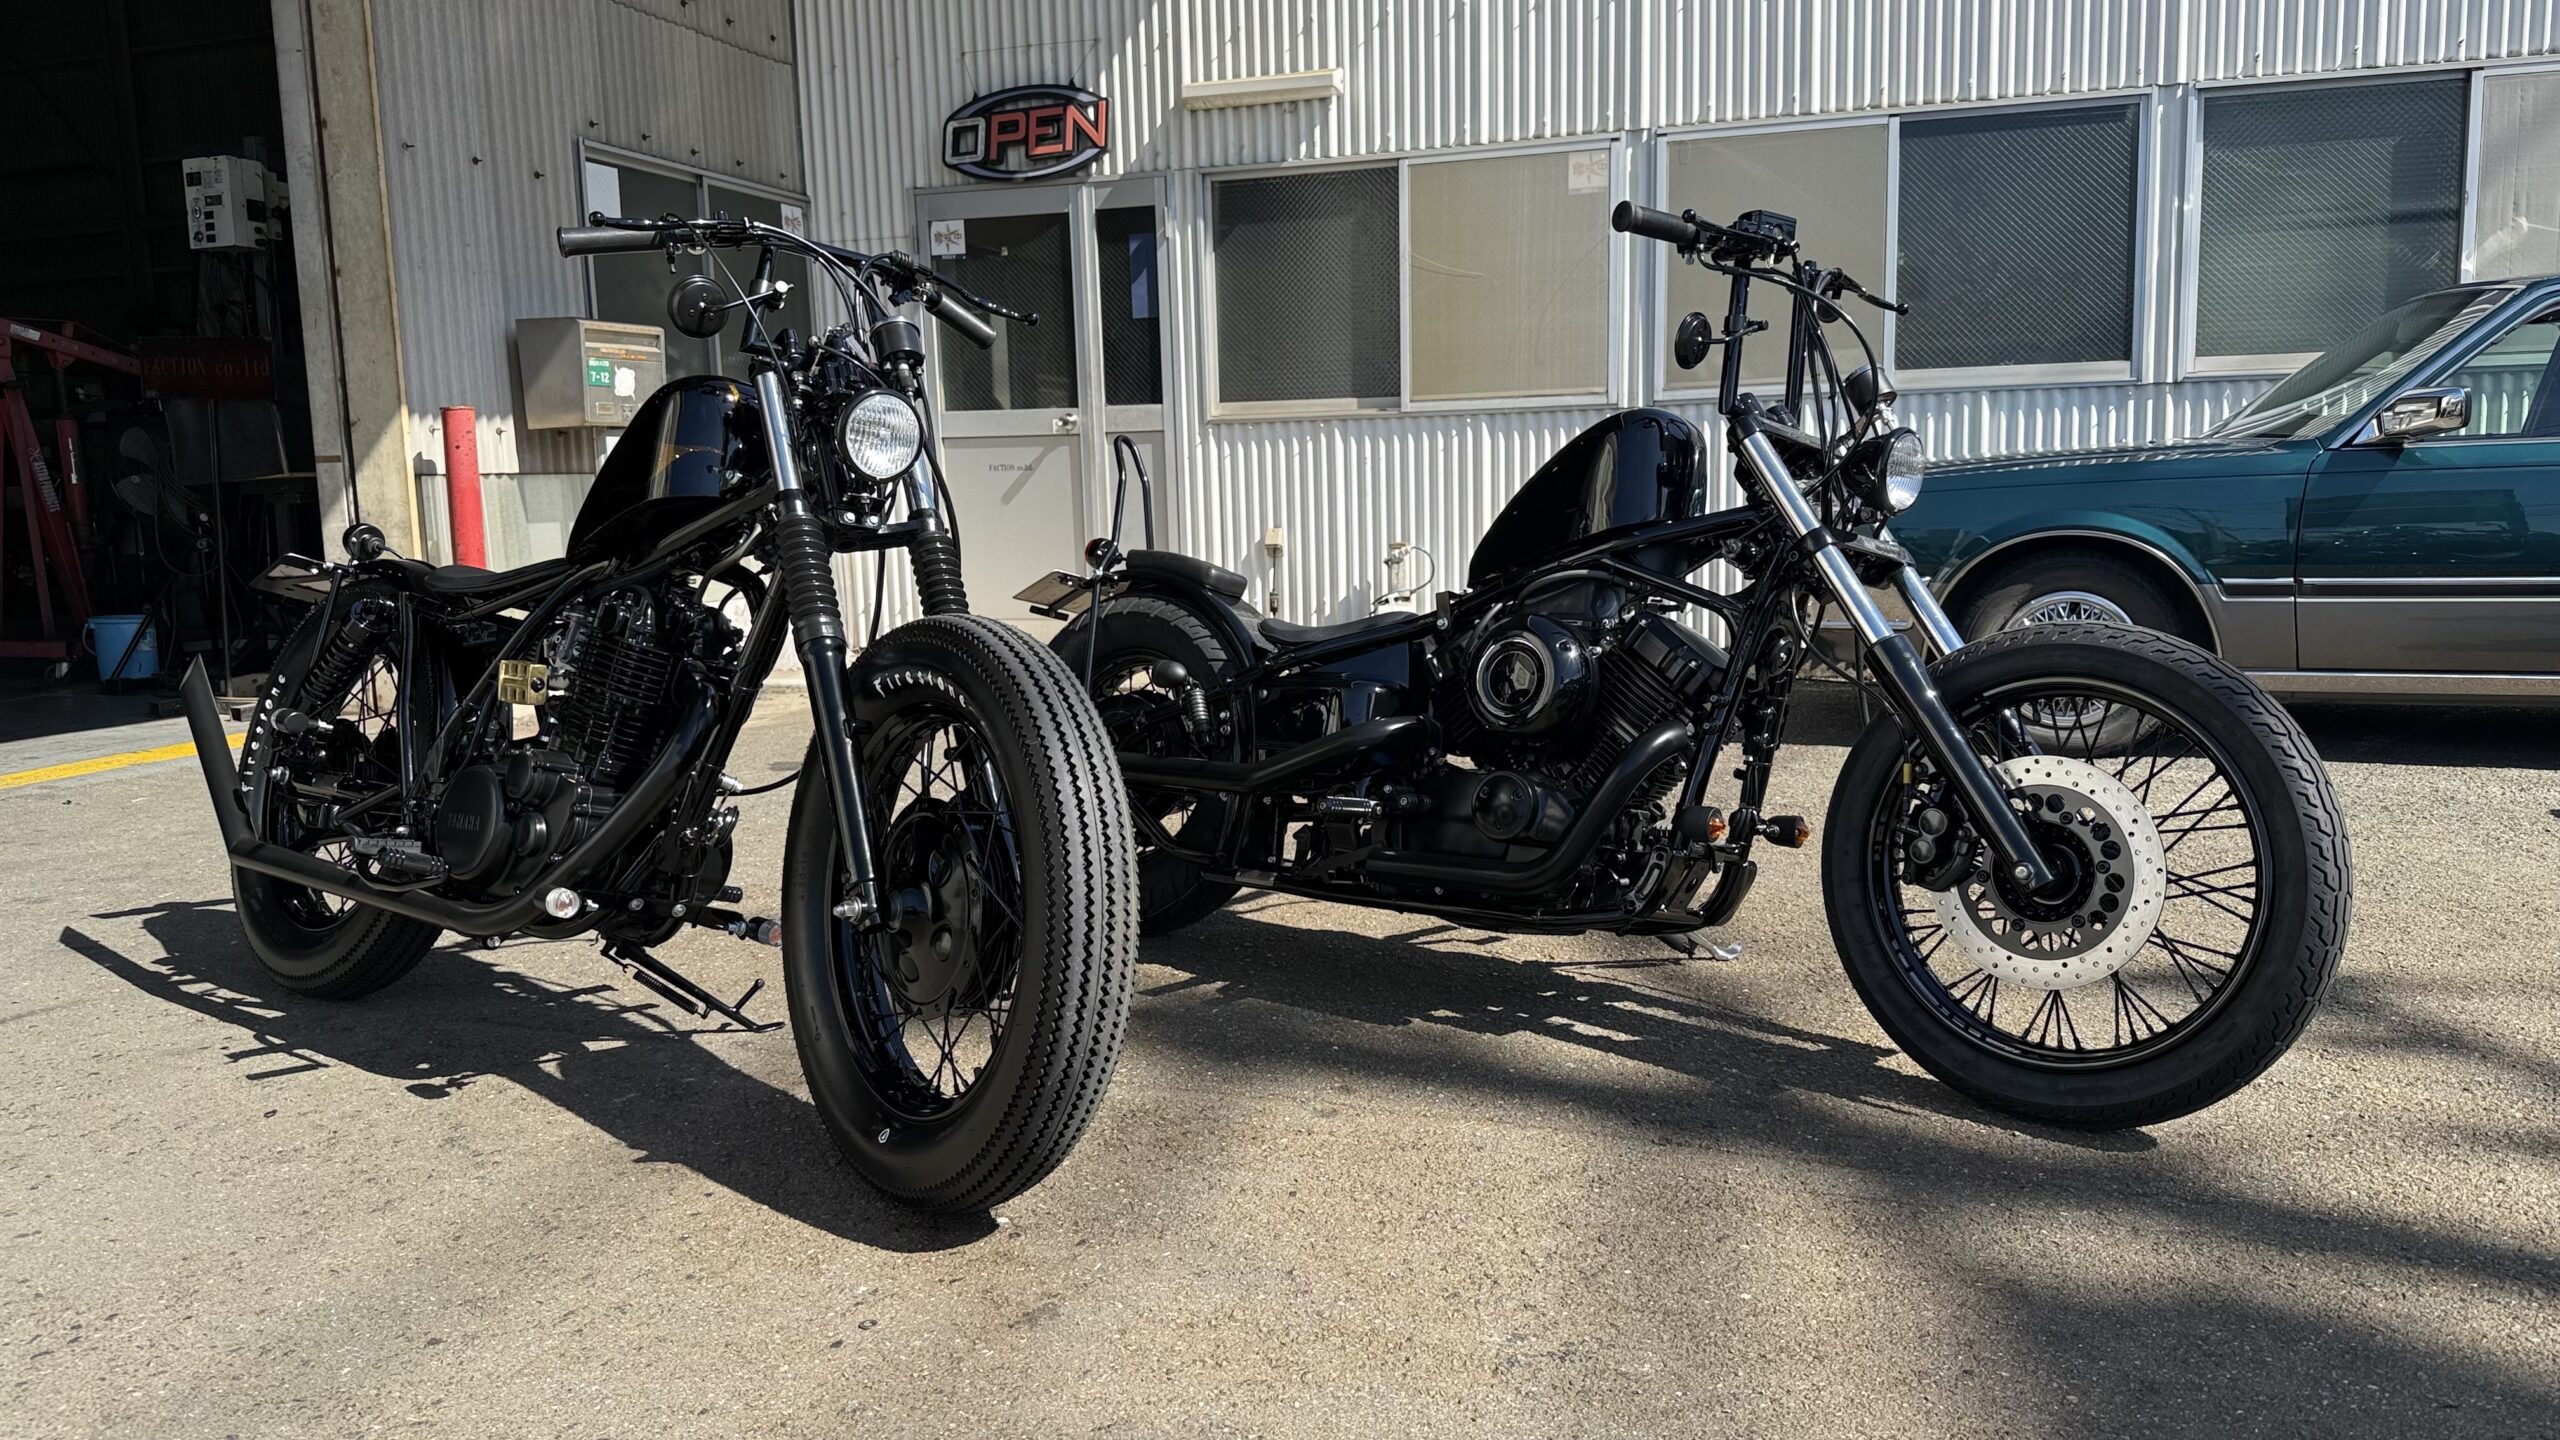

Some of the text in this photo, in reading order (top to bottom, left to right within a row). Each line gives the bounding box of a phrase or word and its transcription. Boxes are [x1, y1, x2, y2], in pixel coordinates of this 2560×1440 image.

[944, 99, 1107, 166] OPEN
[143, 356, 208, 376] FACTION
[873, 670, 966, 708] Firestone
[241, 674, 286, 792] Firestone
